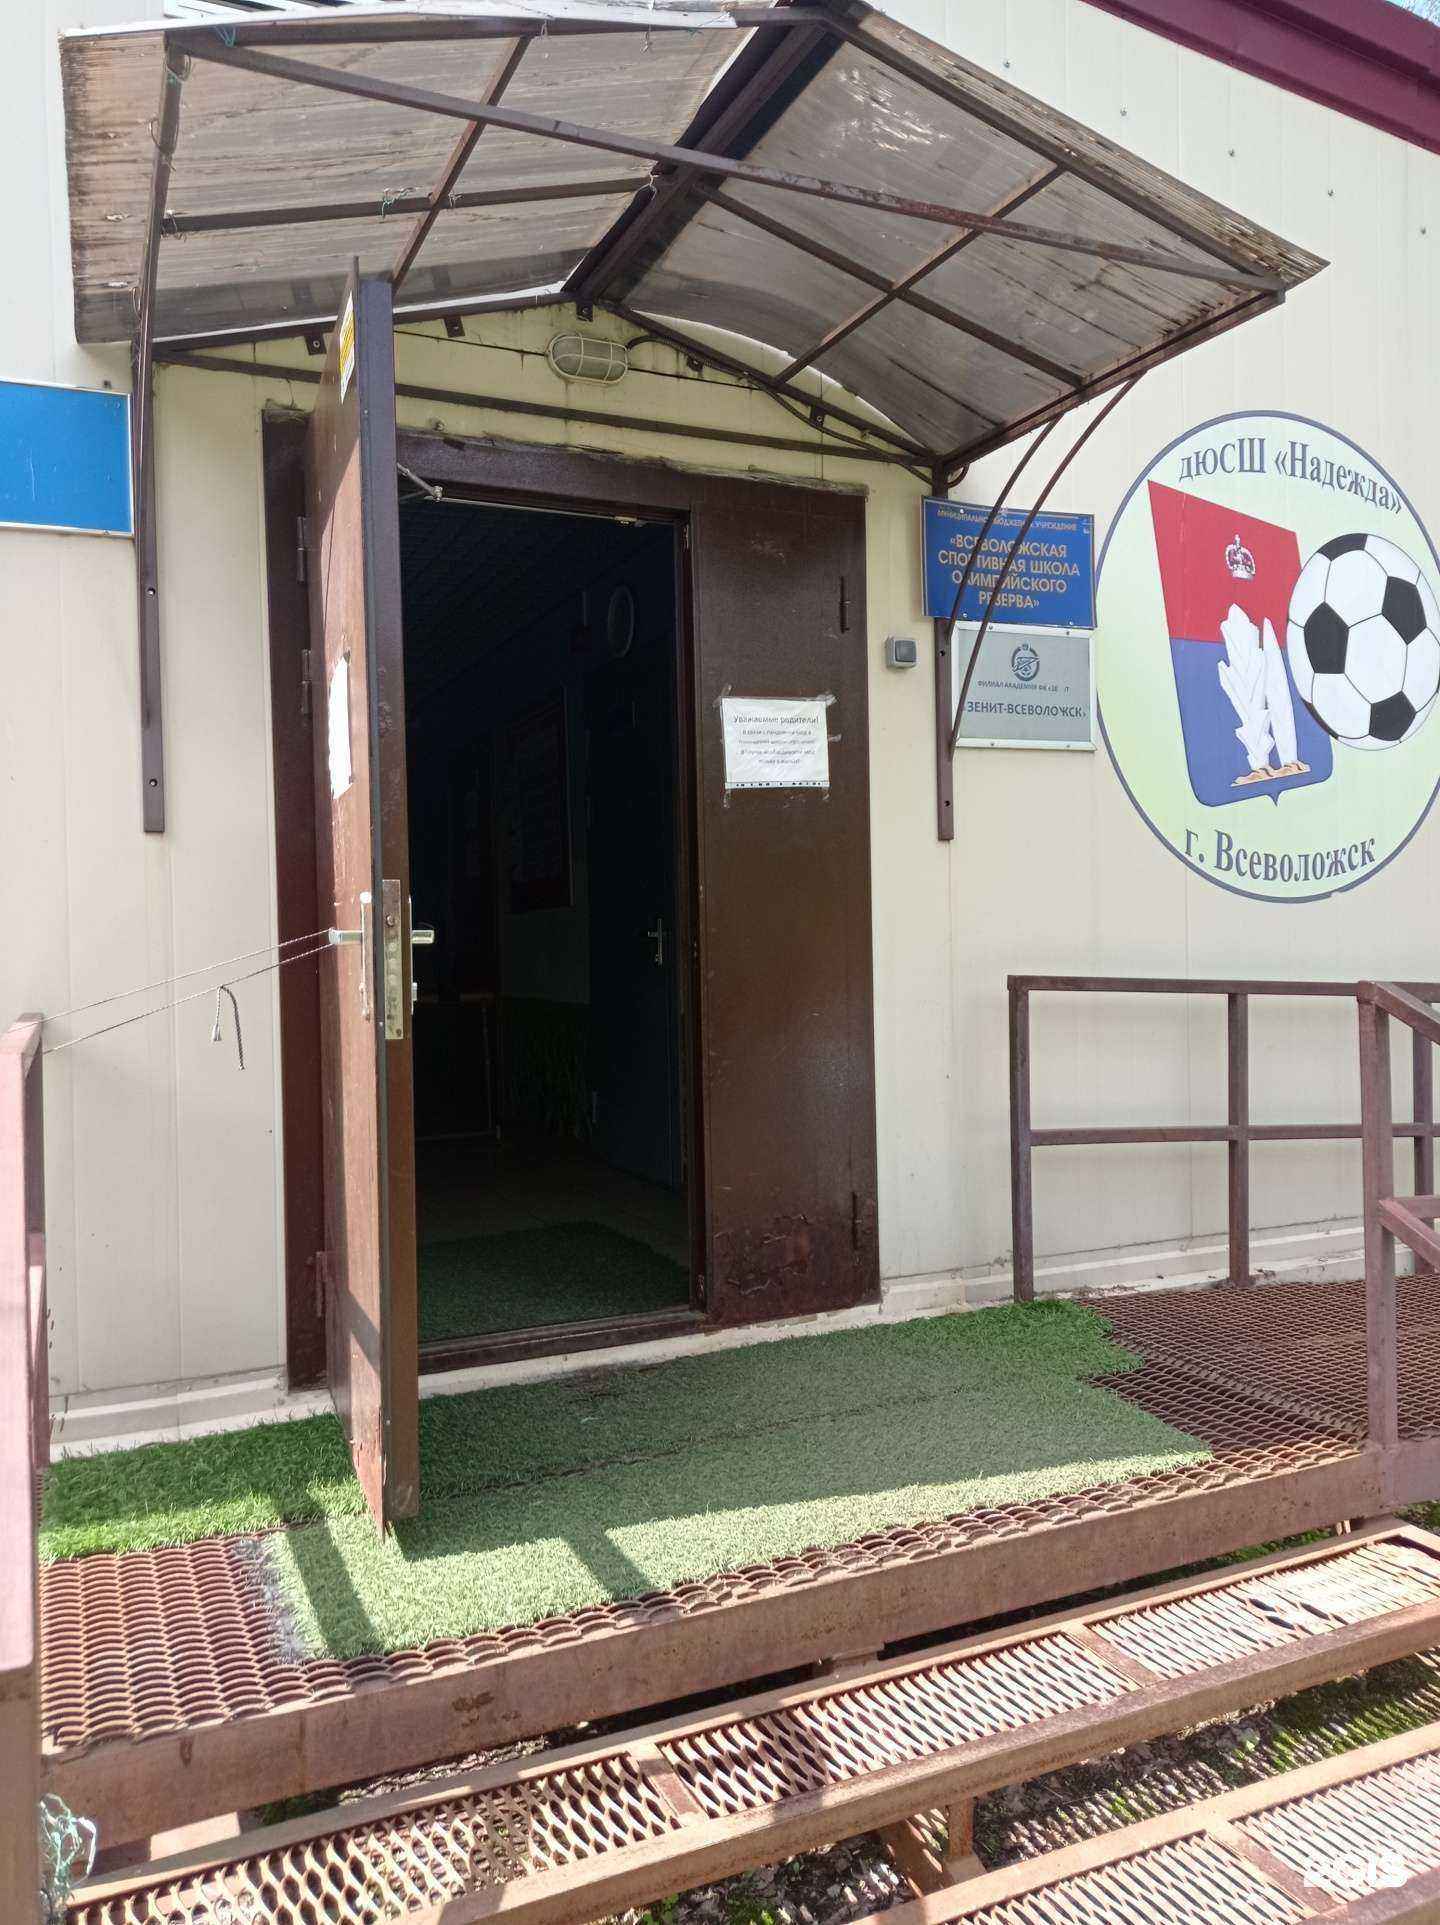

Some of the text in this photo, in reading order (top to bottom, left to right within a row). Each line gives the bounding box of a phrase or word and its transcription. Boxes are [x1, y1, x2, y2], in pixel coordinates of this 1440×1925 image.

[1275, 440, 1402, 514] «Надежда»
[938, 550, 1081, 577] СПОТИВНАЯ ШКОЛА
[1214, 829, 1375, 882] Всеволожск
